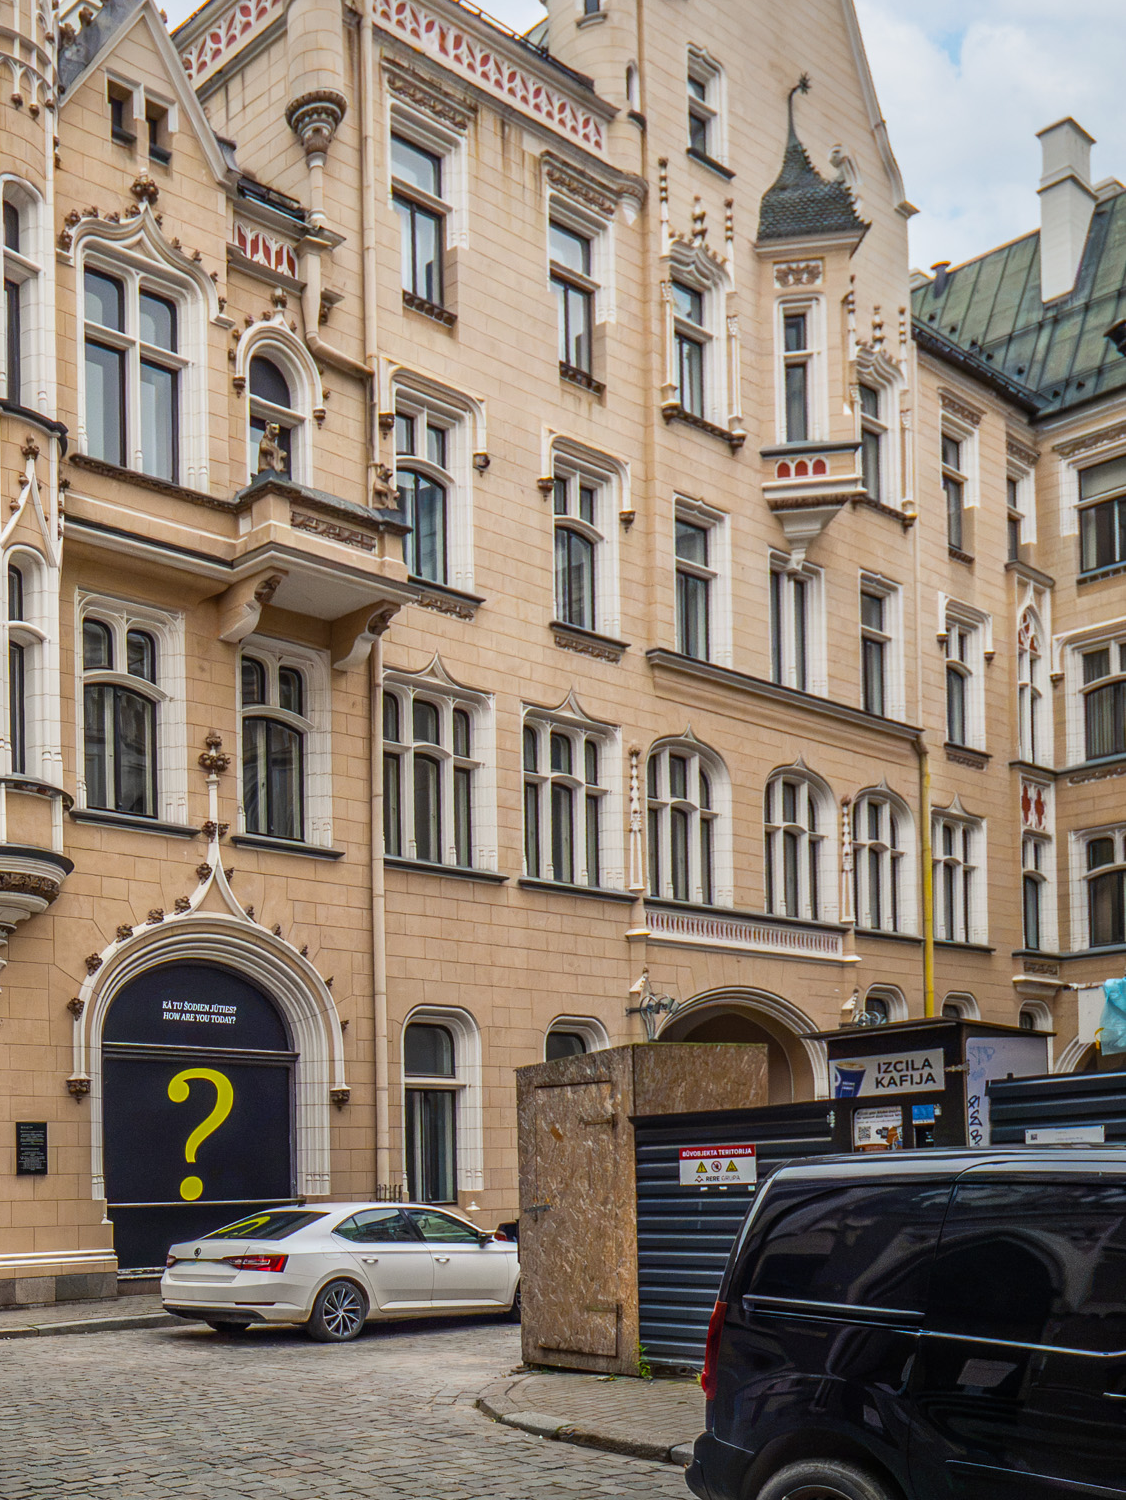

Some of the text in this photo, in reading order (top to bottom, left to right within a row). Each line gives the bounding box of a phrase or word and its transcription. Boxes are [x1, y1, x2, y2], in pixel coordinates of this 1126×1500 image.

[173, 1002, 183, 1010] TU
[183, 1001, 209, 1011] ŠODIEN
[163, 1012, 236, 1024] HOW ARE YOU TODAY?
[877, 1057, 934, 1075] IZCILA
[875, 1072, 936, 1089] KAFIJA
[168, 1067, 234, 1201] ?
[718, 1148, 752, 1156] TERITORIJA
